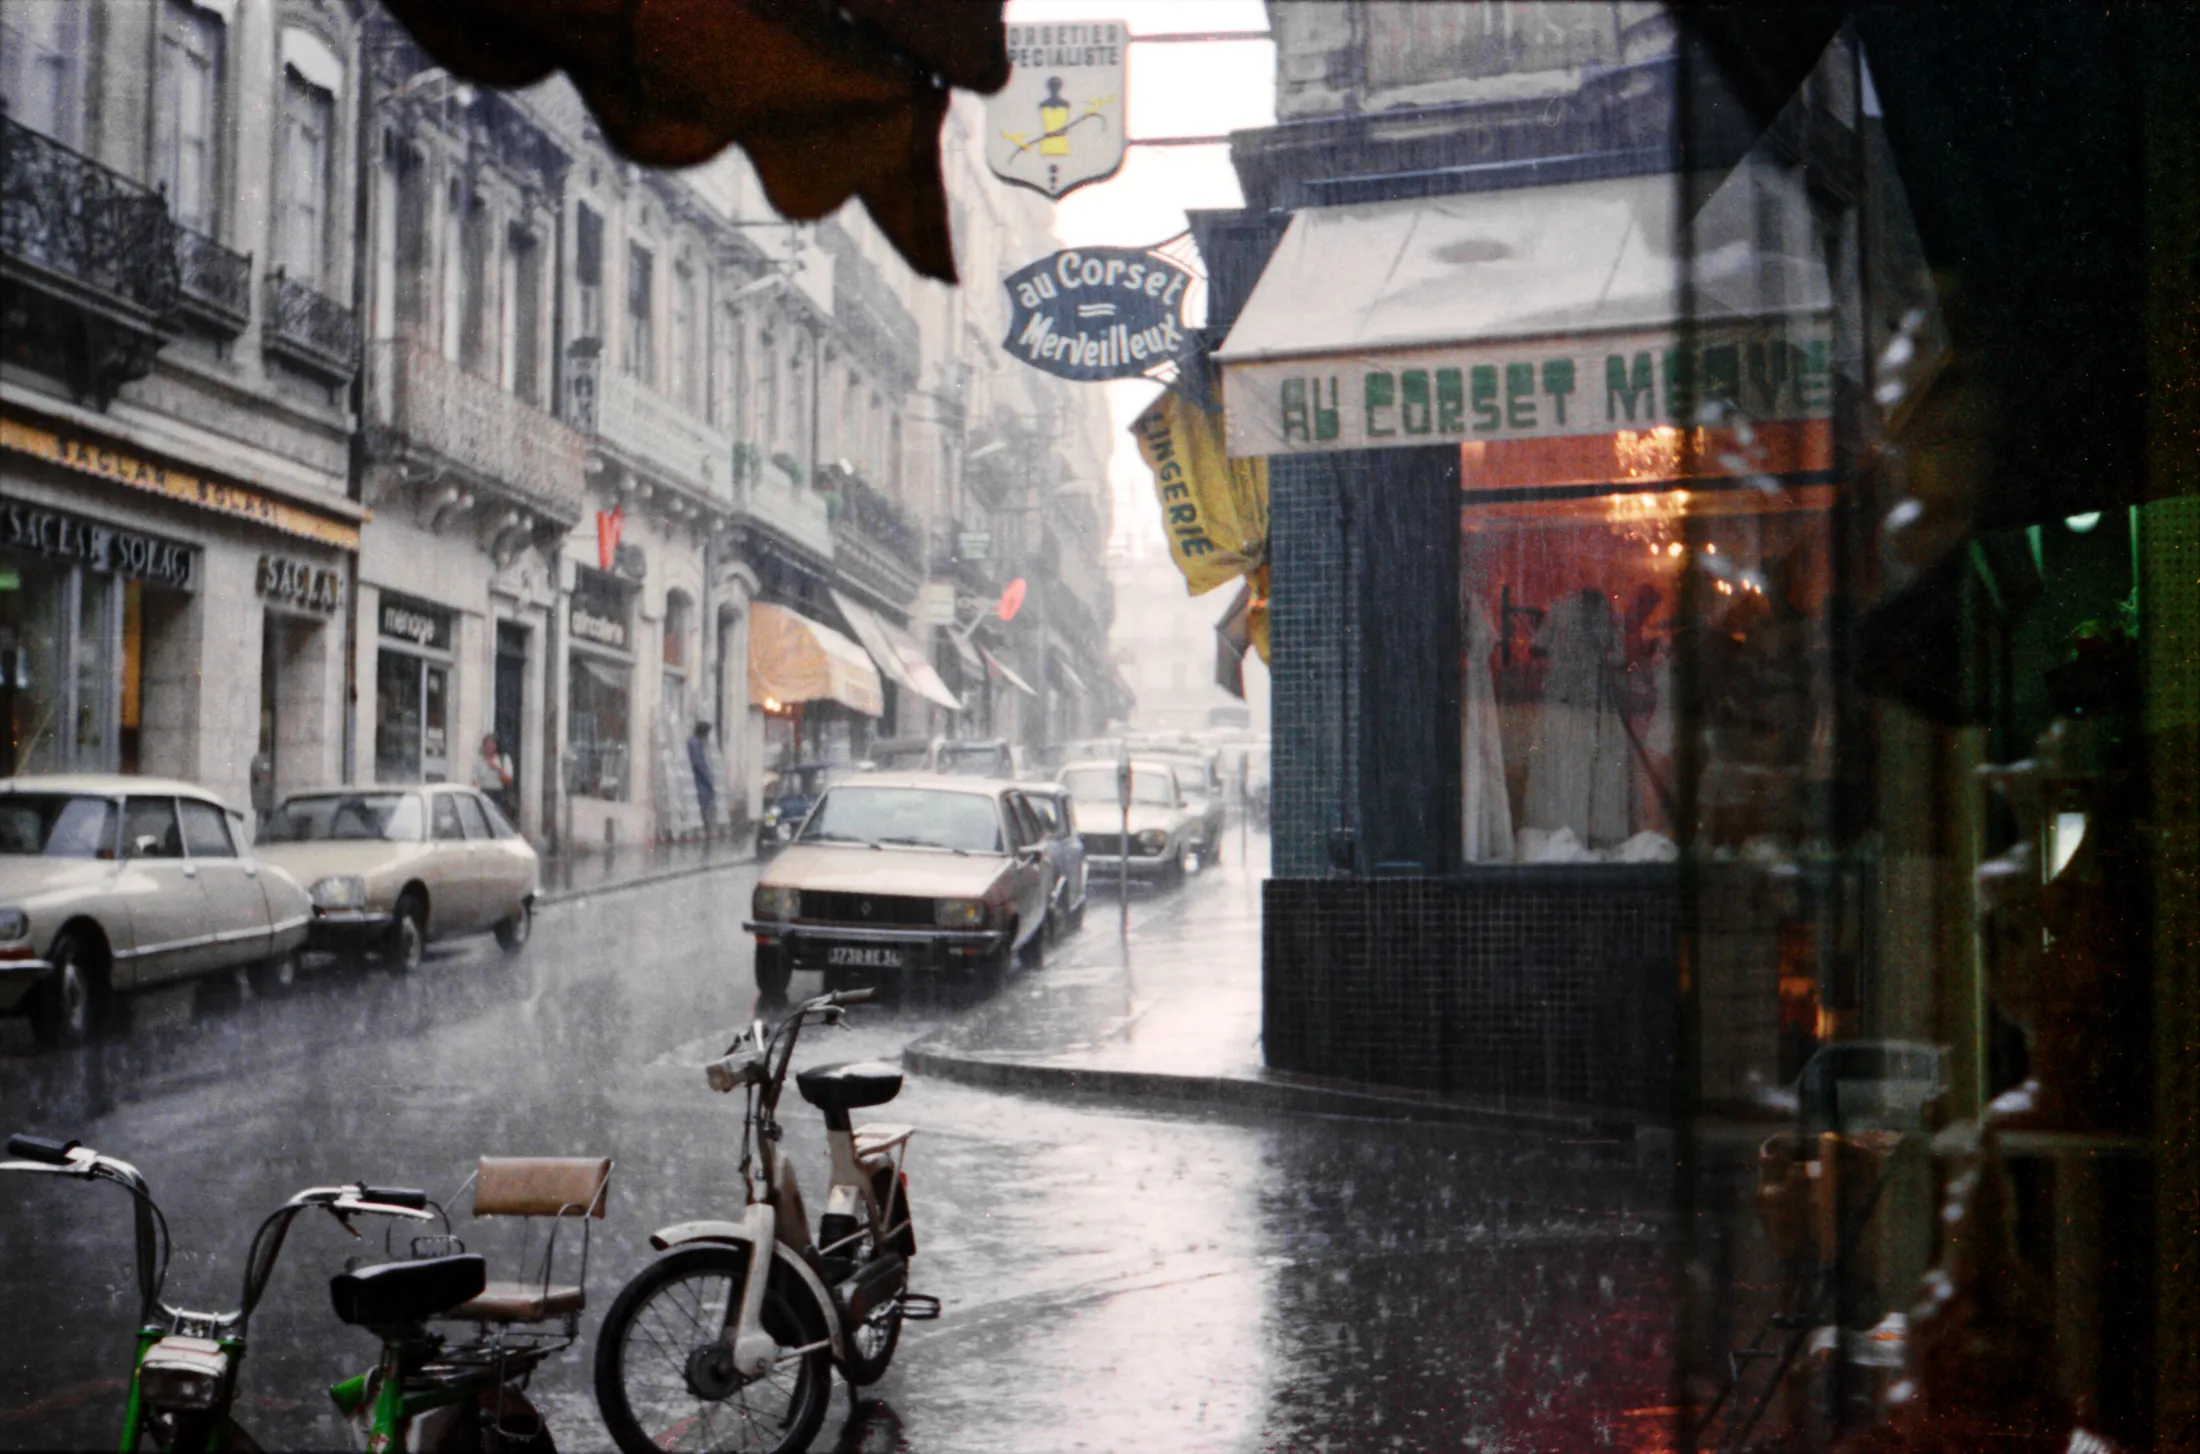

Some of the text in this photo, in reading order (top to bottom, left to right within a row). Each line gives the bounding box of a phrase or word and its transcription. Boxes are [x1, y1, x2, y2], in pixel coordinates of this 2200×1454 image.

[1008, 46, 1119, 68] PECIALISTE
[1009, 23, 1119, 46] ORSETIER
[1016, 251, 1185, 309] au Corset
[1018, 311, 1184, 367] Merveilleux
[1281, 374, 1340, 442] AU
[1364, 357, 1577, 438] CORSET
[1138, 411, 1216, 559] LINGERIE
